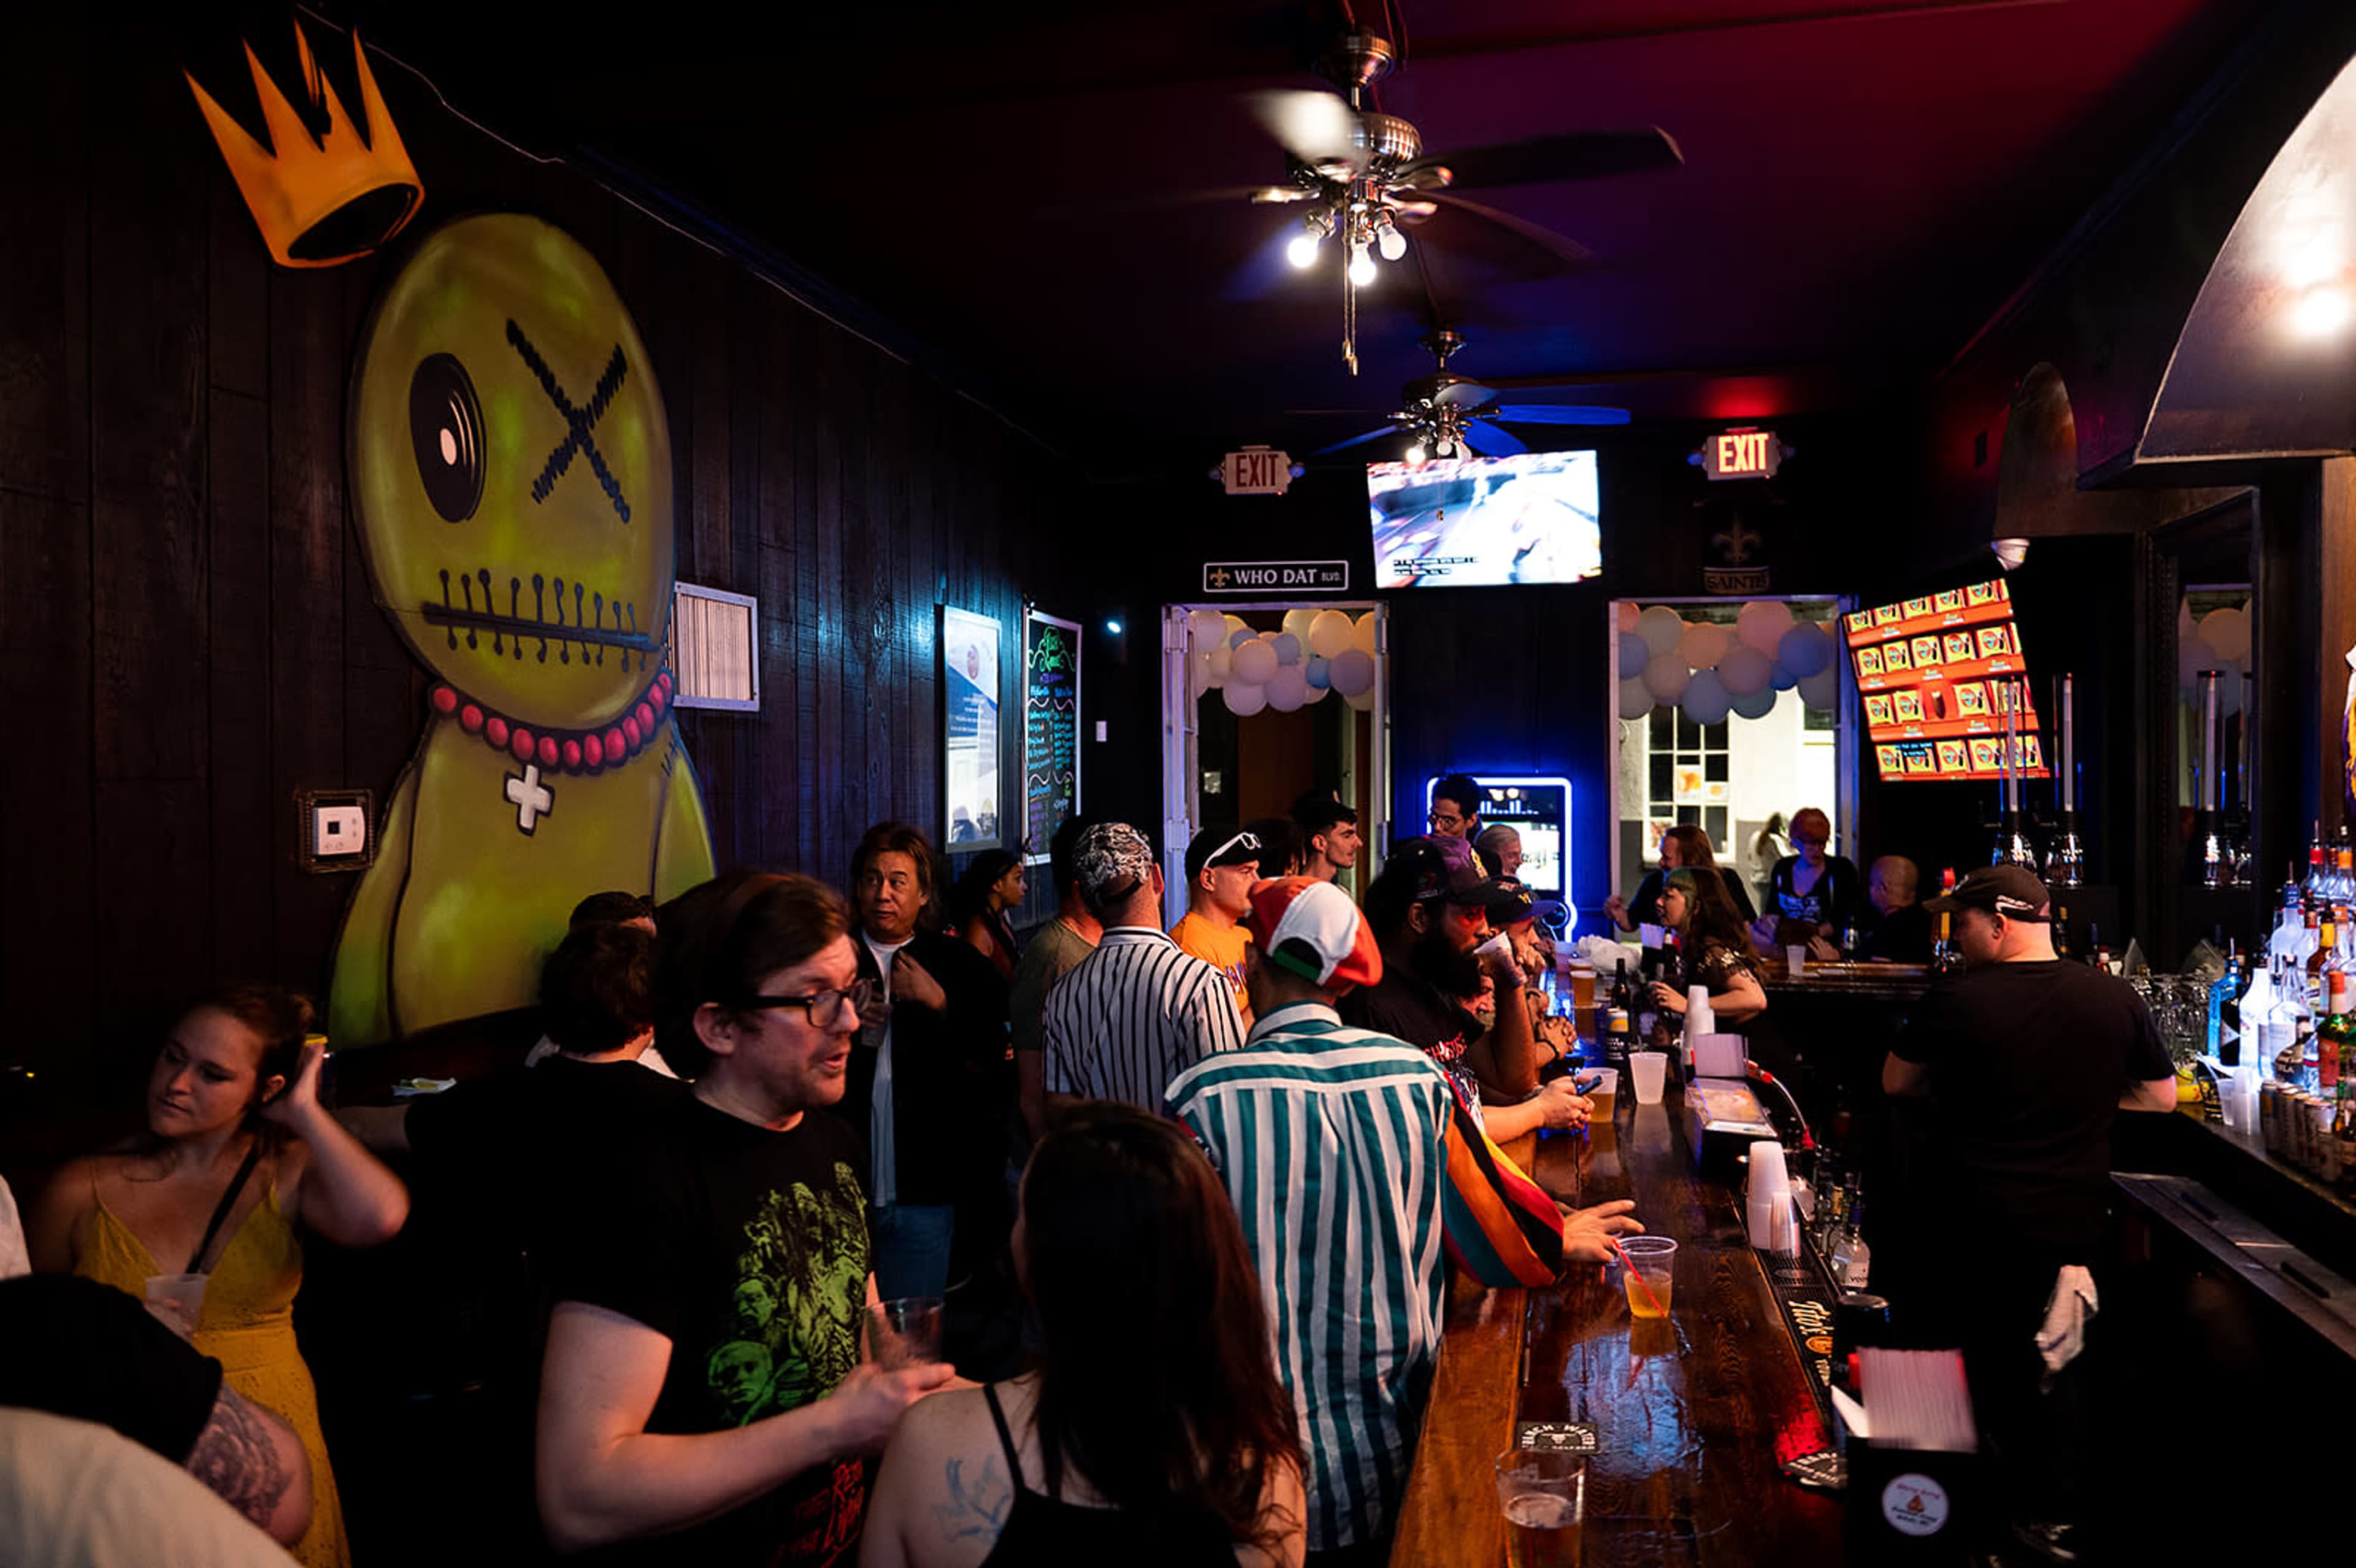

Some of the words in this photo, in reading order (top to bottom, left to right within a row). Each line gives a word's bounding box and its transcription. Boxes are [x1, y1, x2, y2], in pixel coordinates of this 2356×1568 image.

[1718, 433, 1769, 473] EXIT
[1236, 453, 1279, 487] EXIT
[1234, 569, 1277, 584] WHO
[1283, 569, 1317, 583] DAT
[1707, 576, 1767, 590] SAINTS
